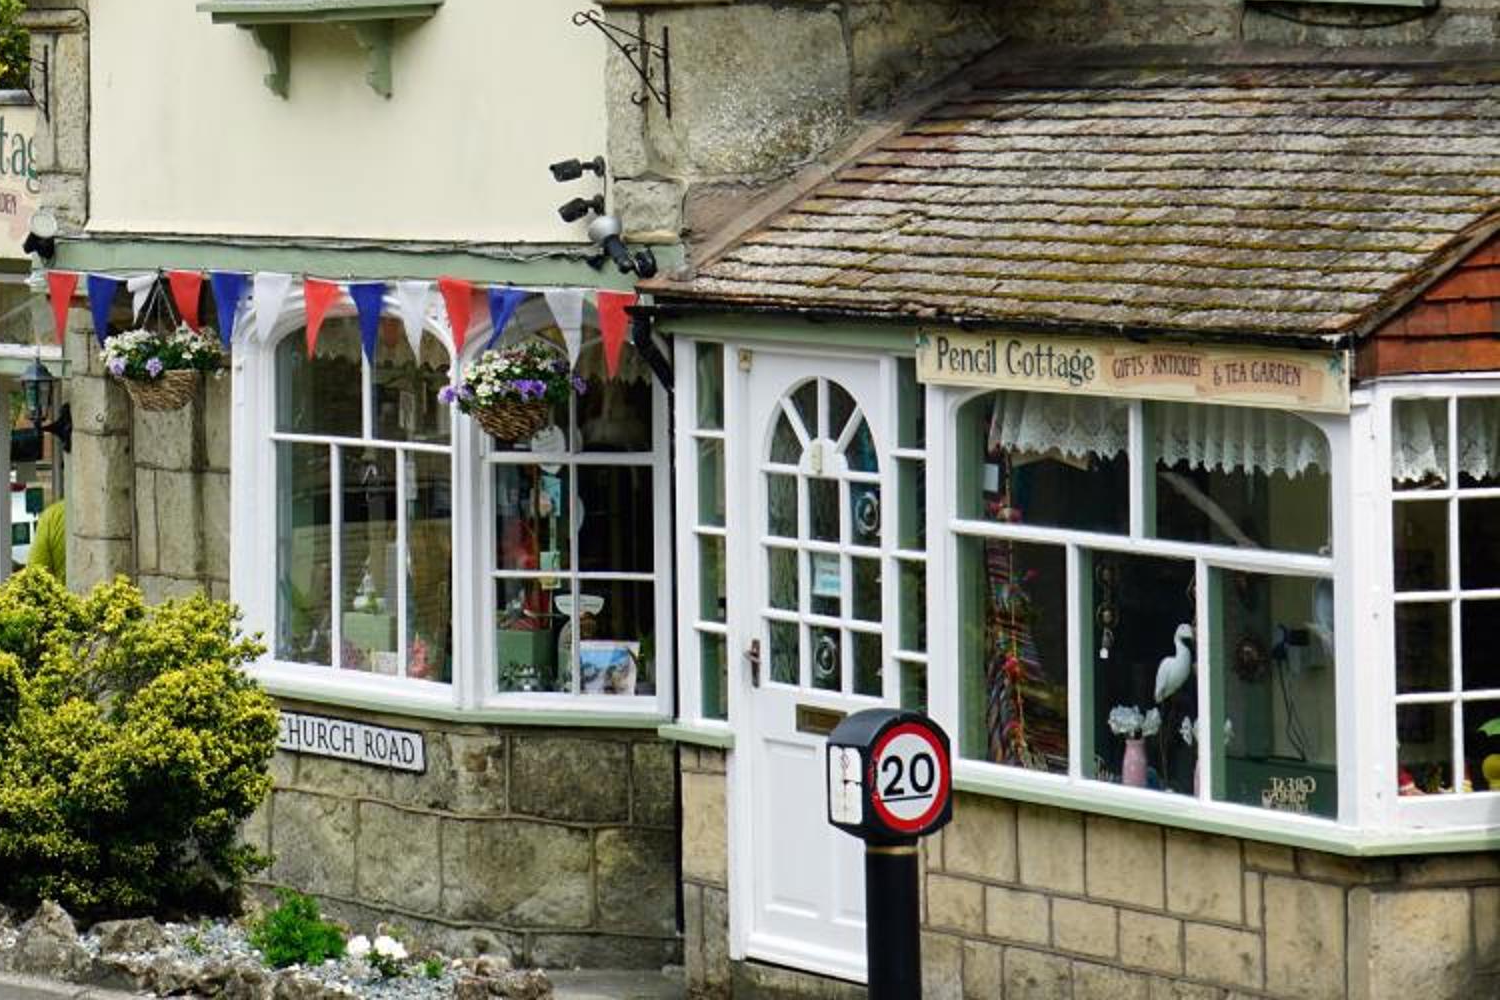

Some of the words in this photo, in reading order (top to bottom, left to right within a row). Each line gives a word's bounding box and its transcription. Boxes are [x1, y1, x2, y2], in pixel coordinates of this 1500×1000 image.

[937, 335, 997, 373] Pencil
[1005, 338, 1096, 386] Cottage
[1151, 353, 1202, 377] ANTIQUES
[1225, 360, 1248, 385] TEA
[1251, 360, 1302, 387] GARDEN
[363, 729, 415, 764] ROAD
[882, 752, 934, 796] 20
